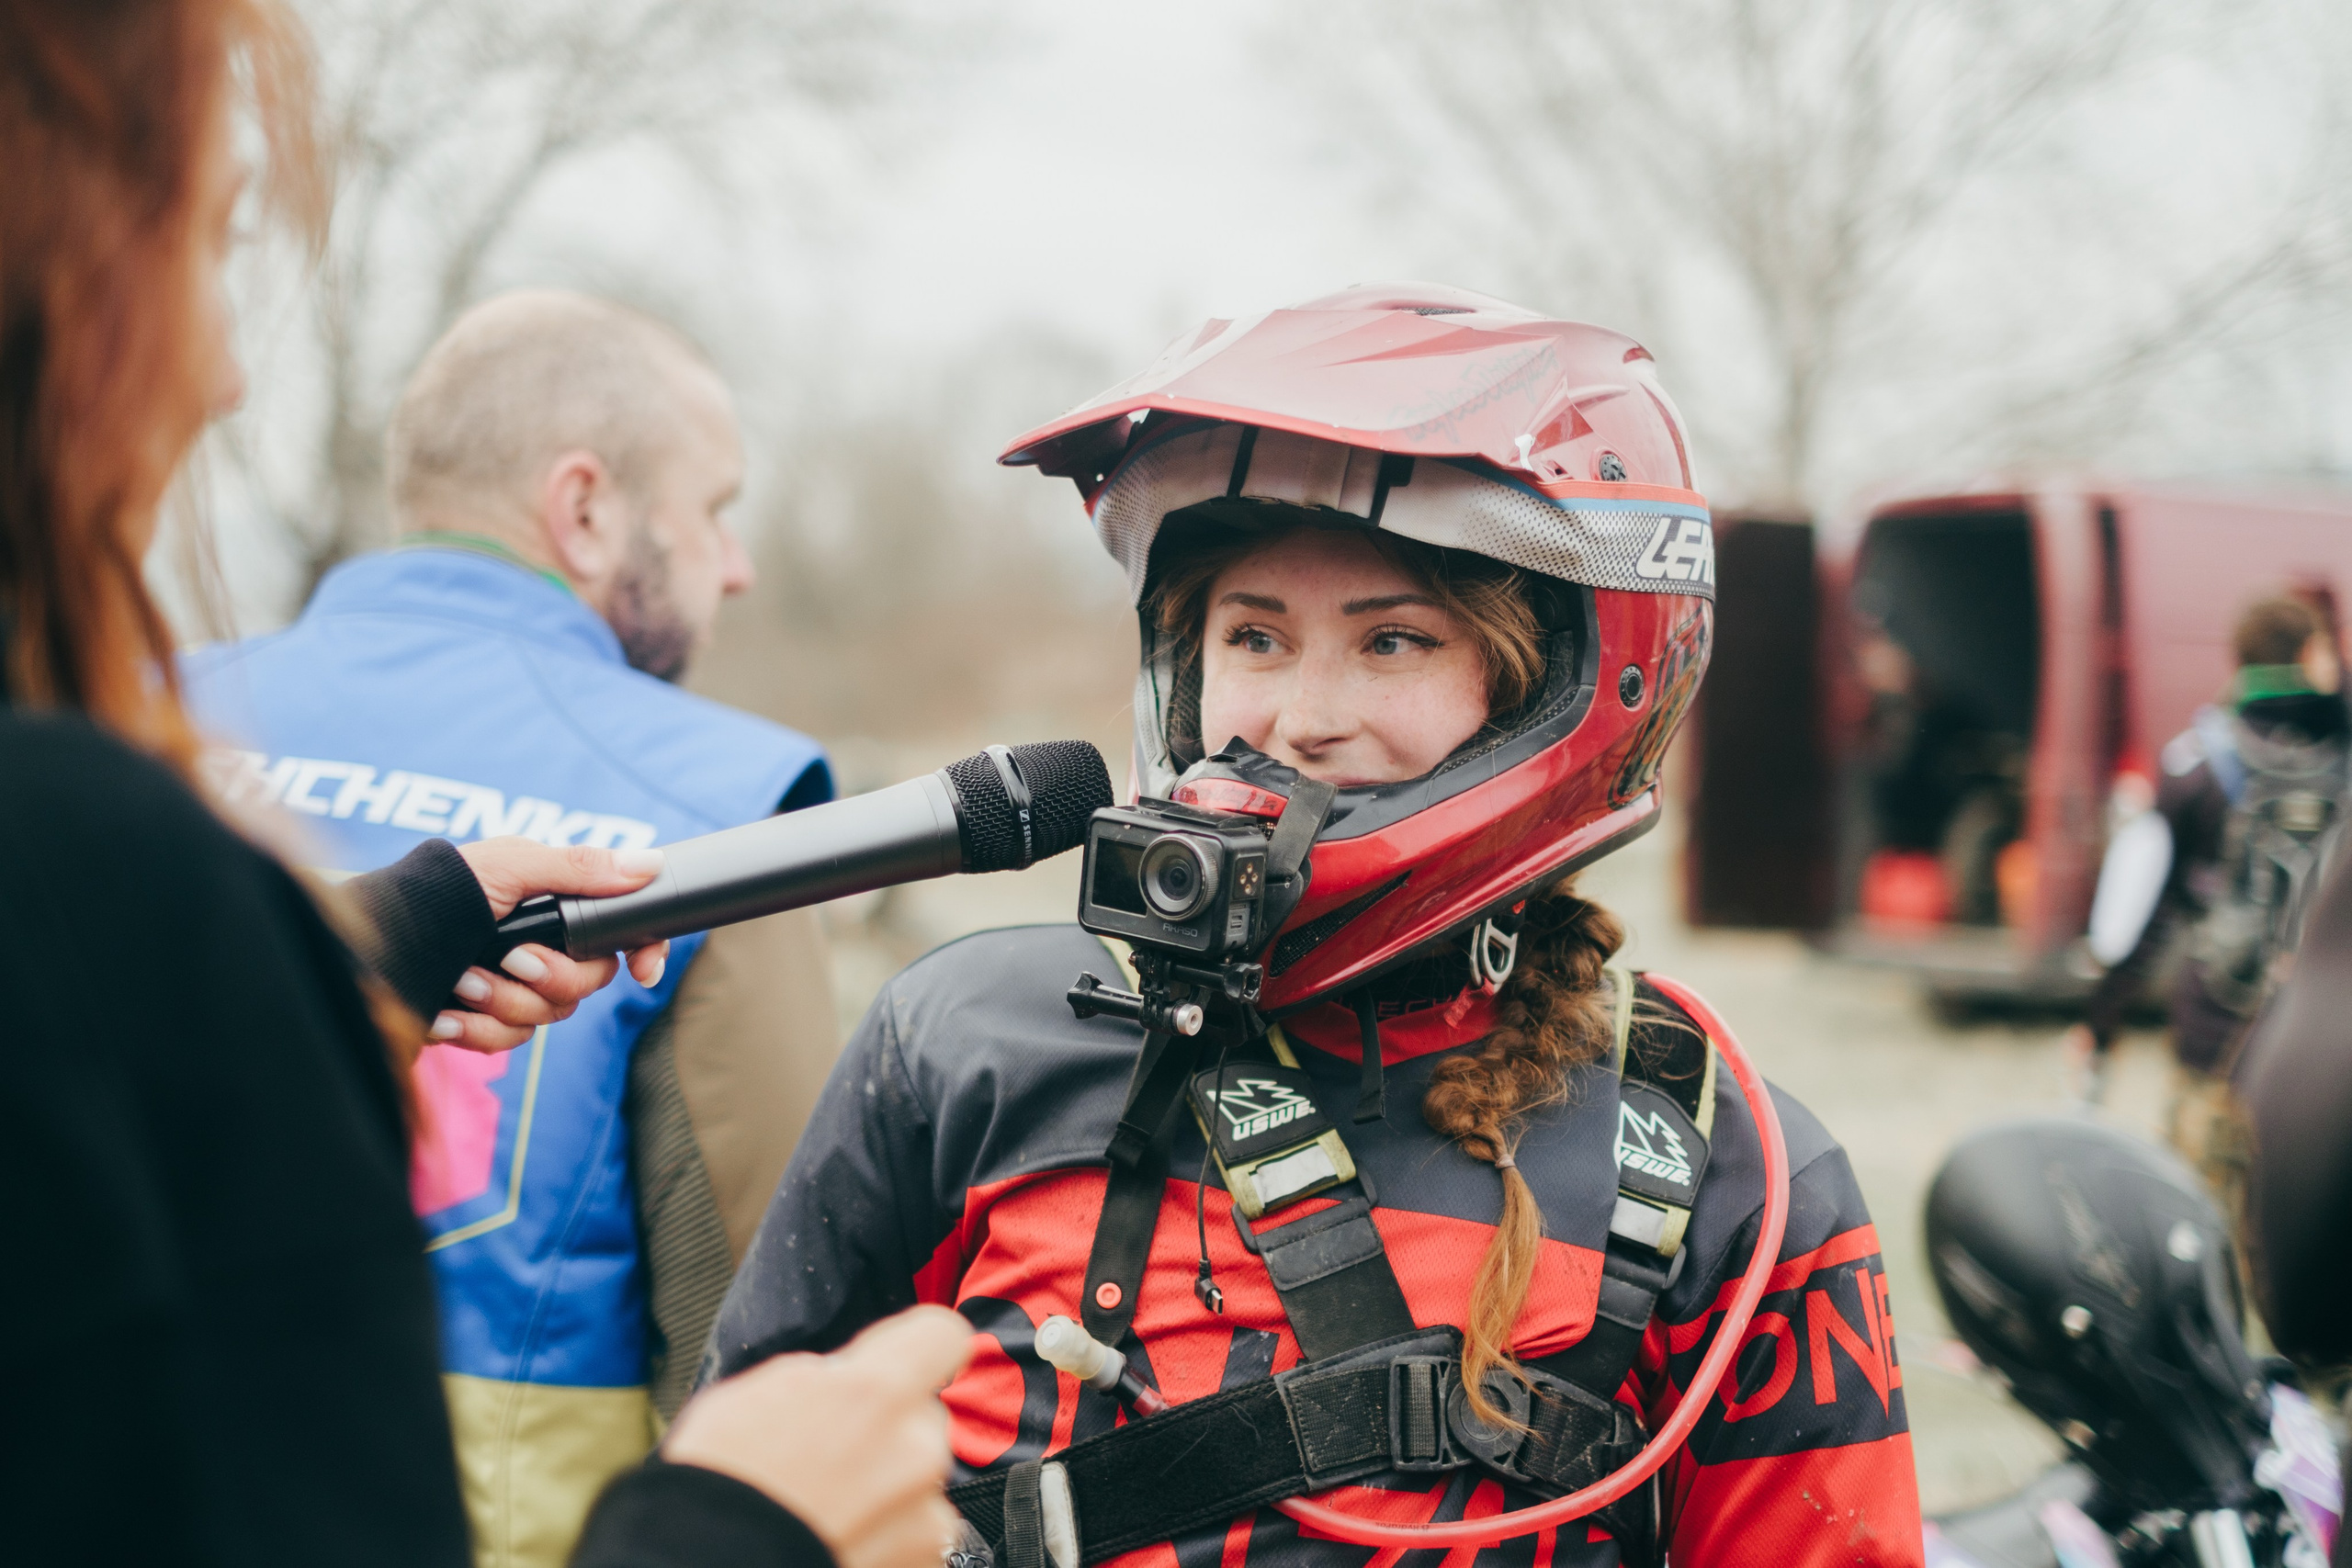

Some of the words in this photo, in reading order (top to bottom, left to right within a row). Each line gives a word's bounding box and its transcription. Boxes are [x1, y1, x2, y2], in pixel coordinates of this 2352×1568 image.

[1635, 516, 1714, 583] LEA
[1162, 922, 1198, 937] AKASO
[1232, 1100, 1311, 1141] USWE
